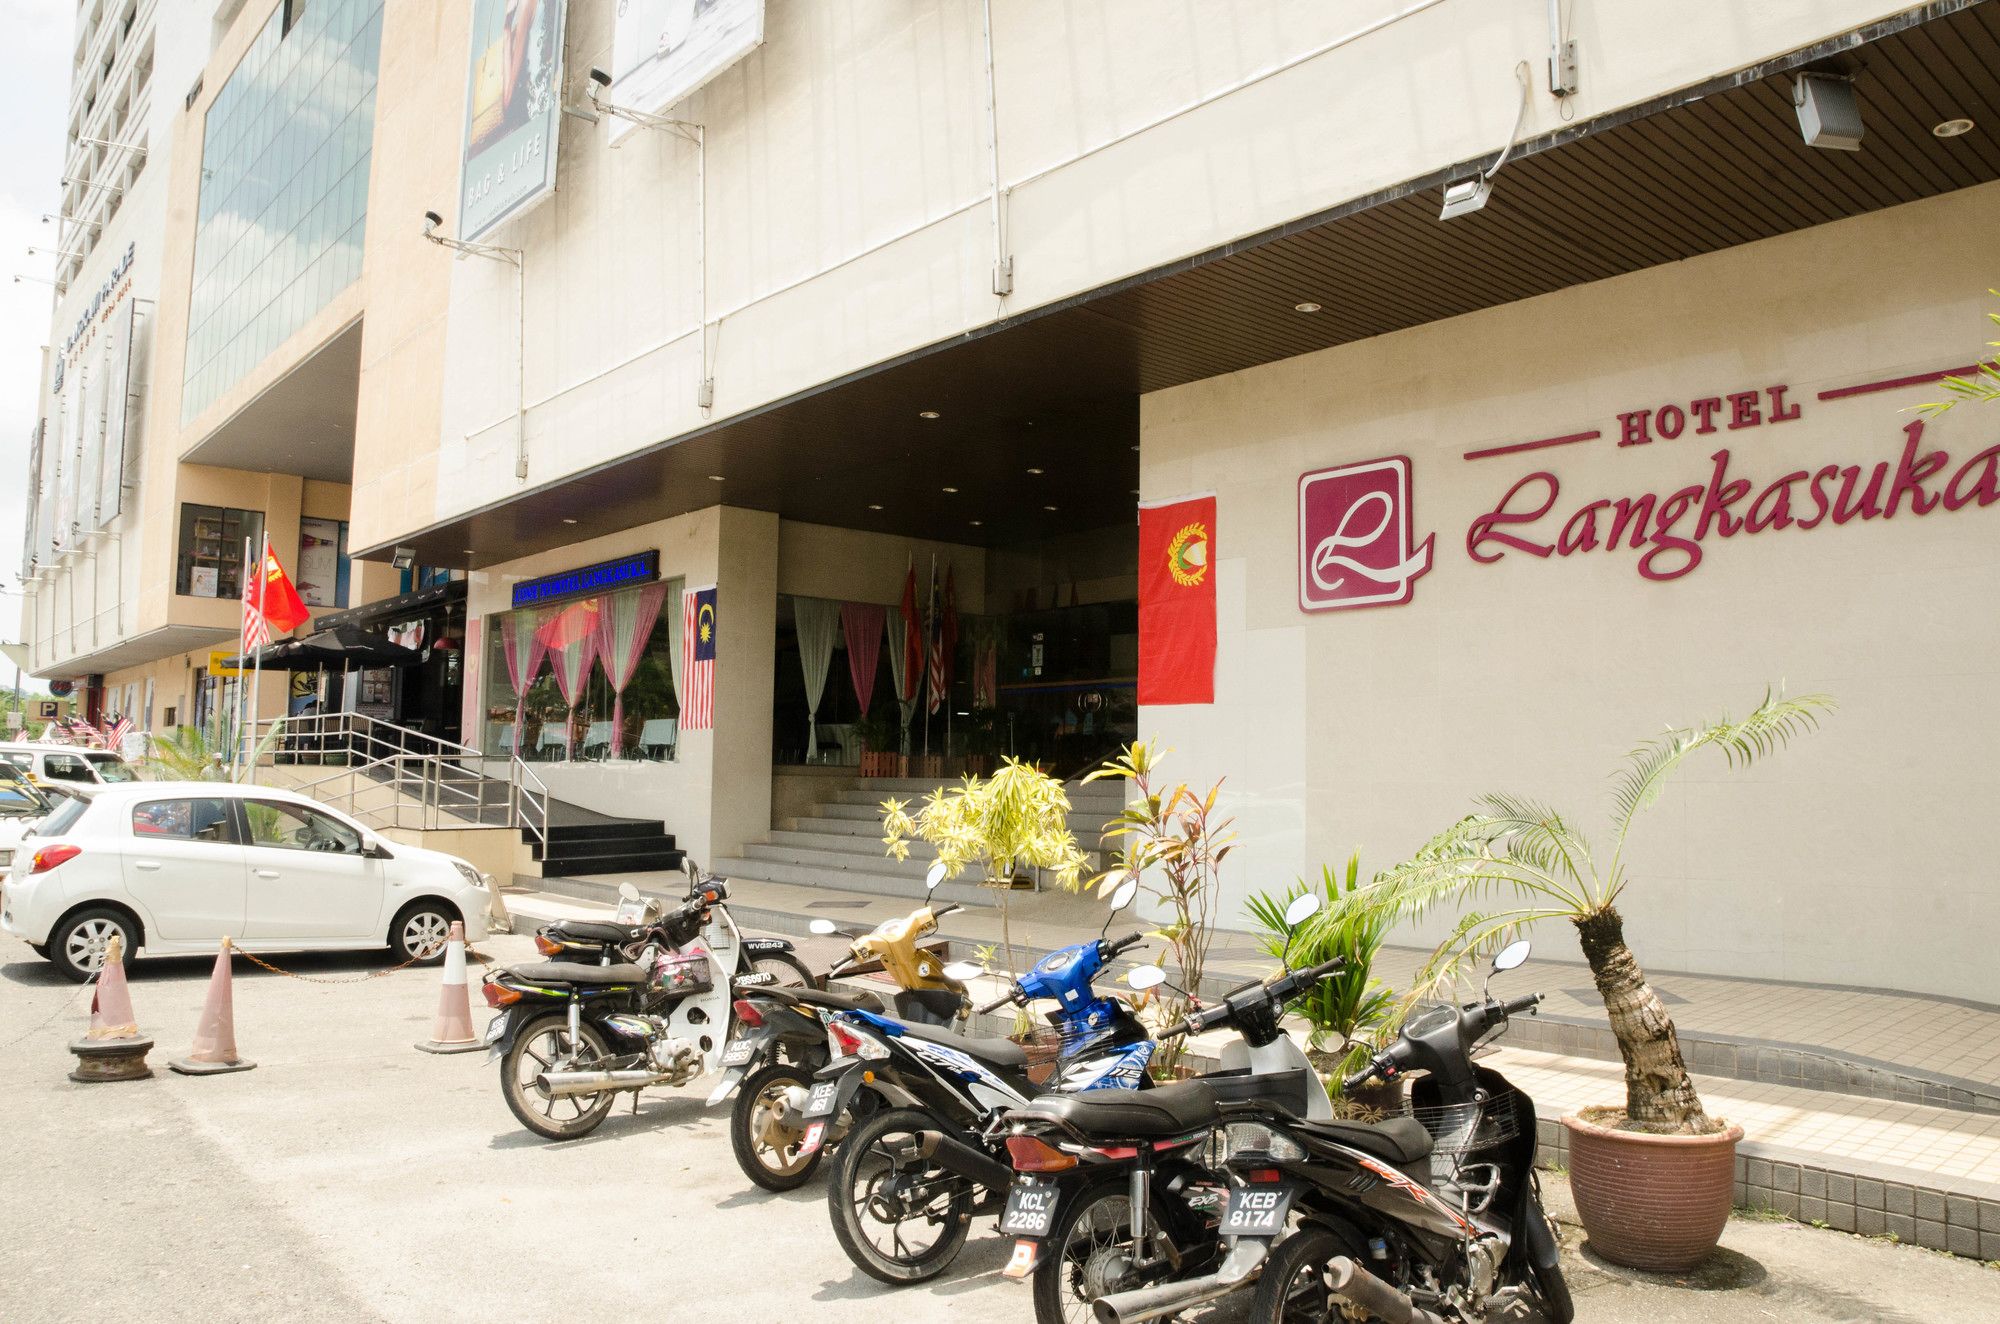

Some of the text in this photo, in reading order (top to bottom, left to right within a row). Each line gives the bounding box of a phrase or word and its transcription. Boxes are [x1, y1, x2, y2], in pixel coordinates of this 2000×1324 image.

[512, 132, 542, 174] LIFE
[1615, 384, 1802, 448] HOTEL
[1466, 418, 2000, 582] Langkasuka
[1019, 1193, 1045, 1211] KCL
[1240, 1192, 1277, 1209] KEB
[1007, 1211, 1047, 1230] 2286
[1230, 1211, 1276, 1227] 8174
